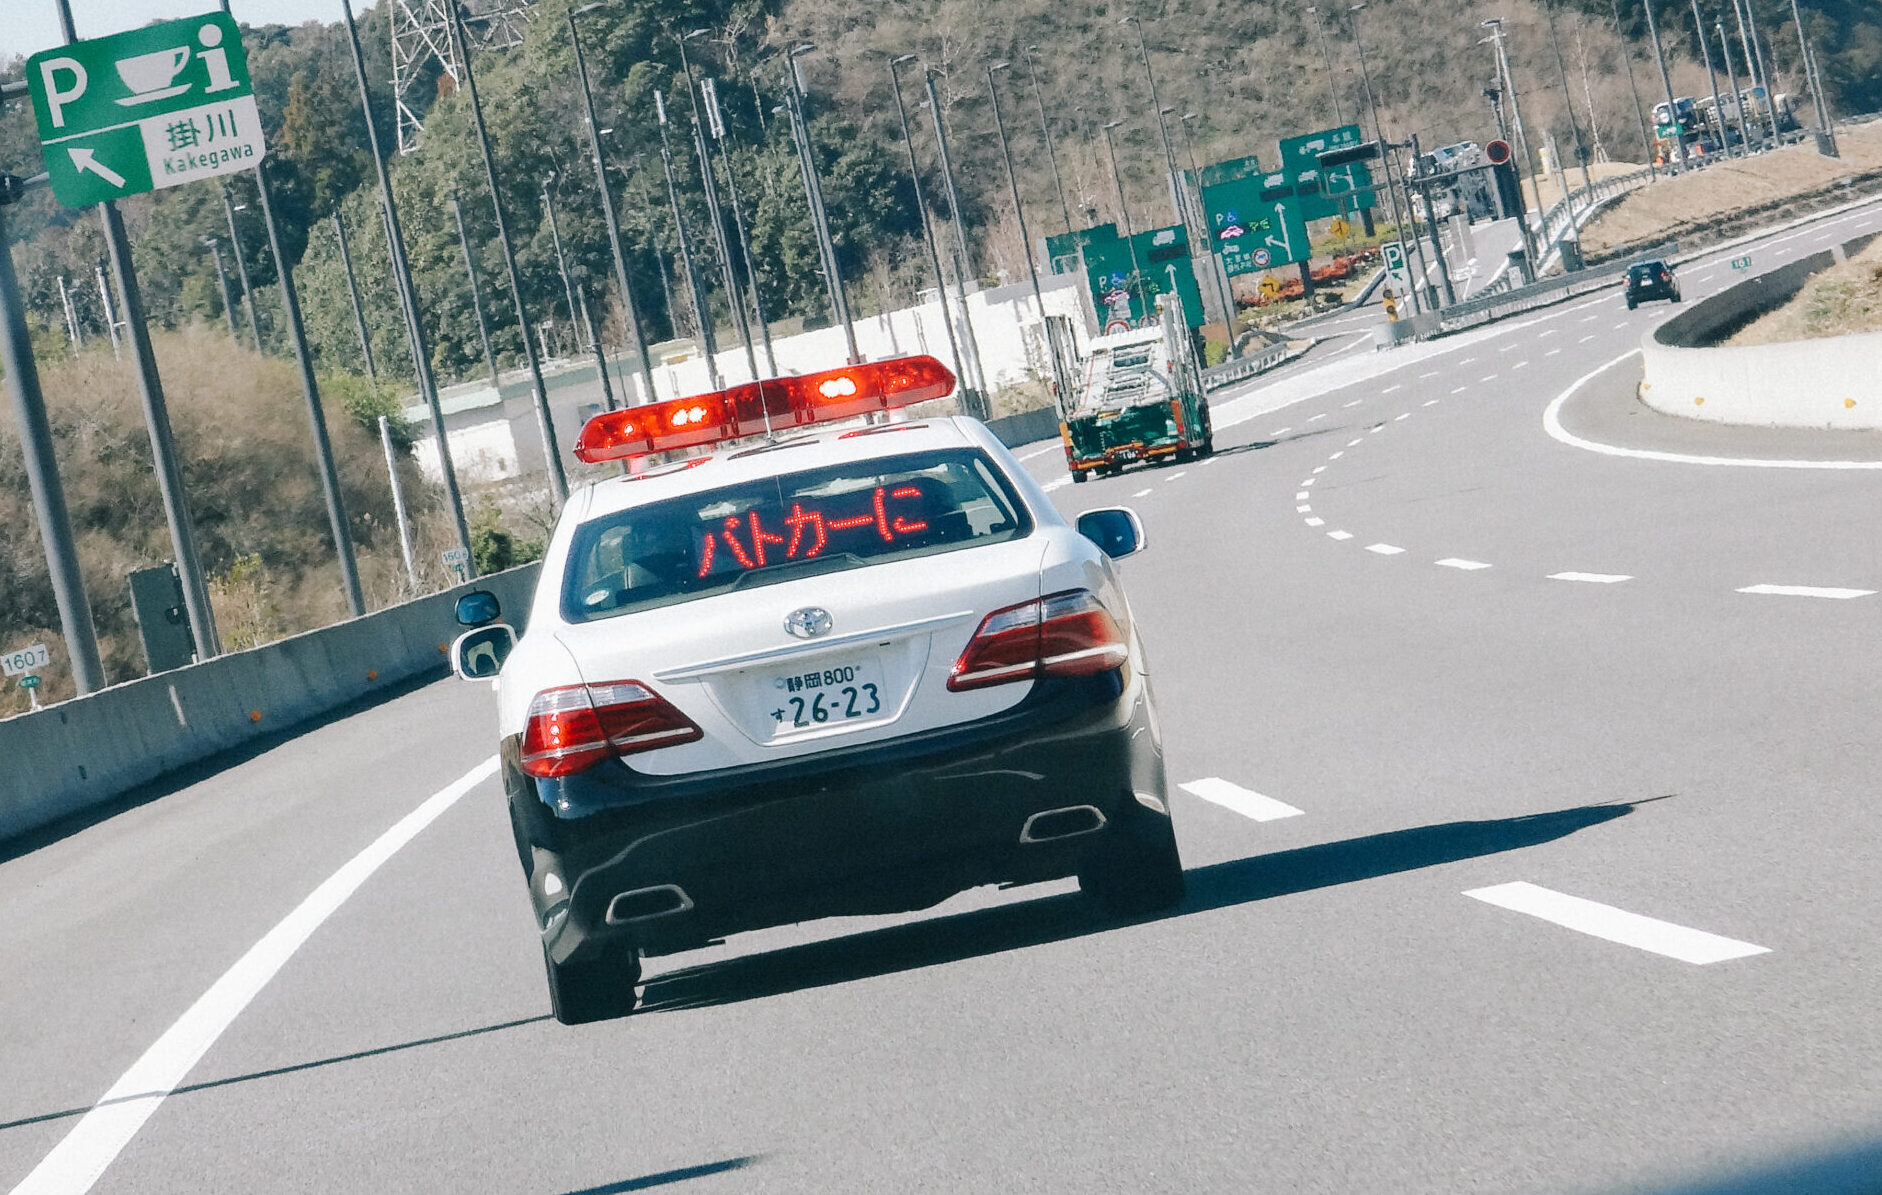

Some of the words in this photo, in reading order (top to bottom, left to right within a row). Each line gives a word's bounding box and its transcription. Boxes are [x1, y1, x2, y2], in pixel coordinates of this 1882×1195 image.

[165, 109, 238, 152] 掛川
[163, 144, 253, 175] Kakegawa
[698, 486, 928, 578] パトカーに
